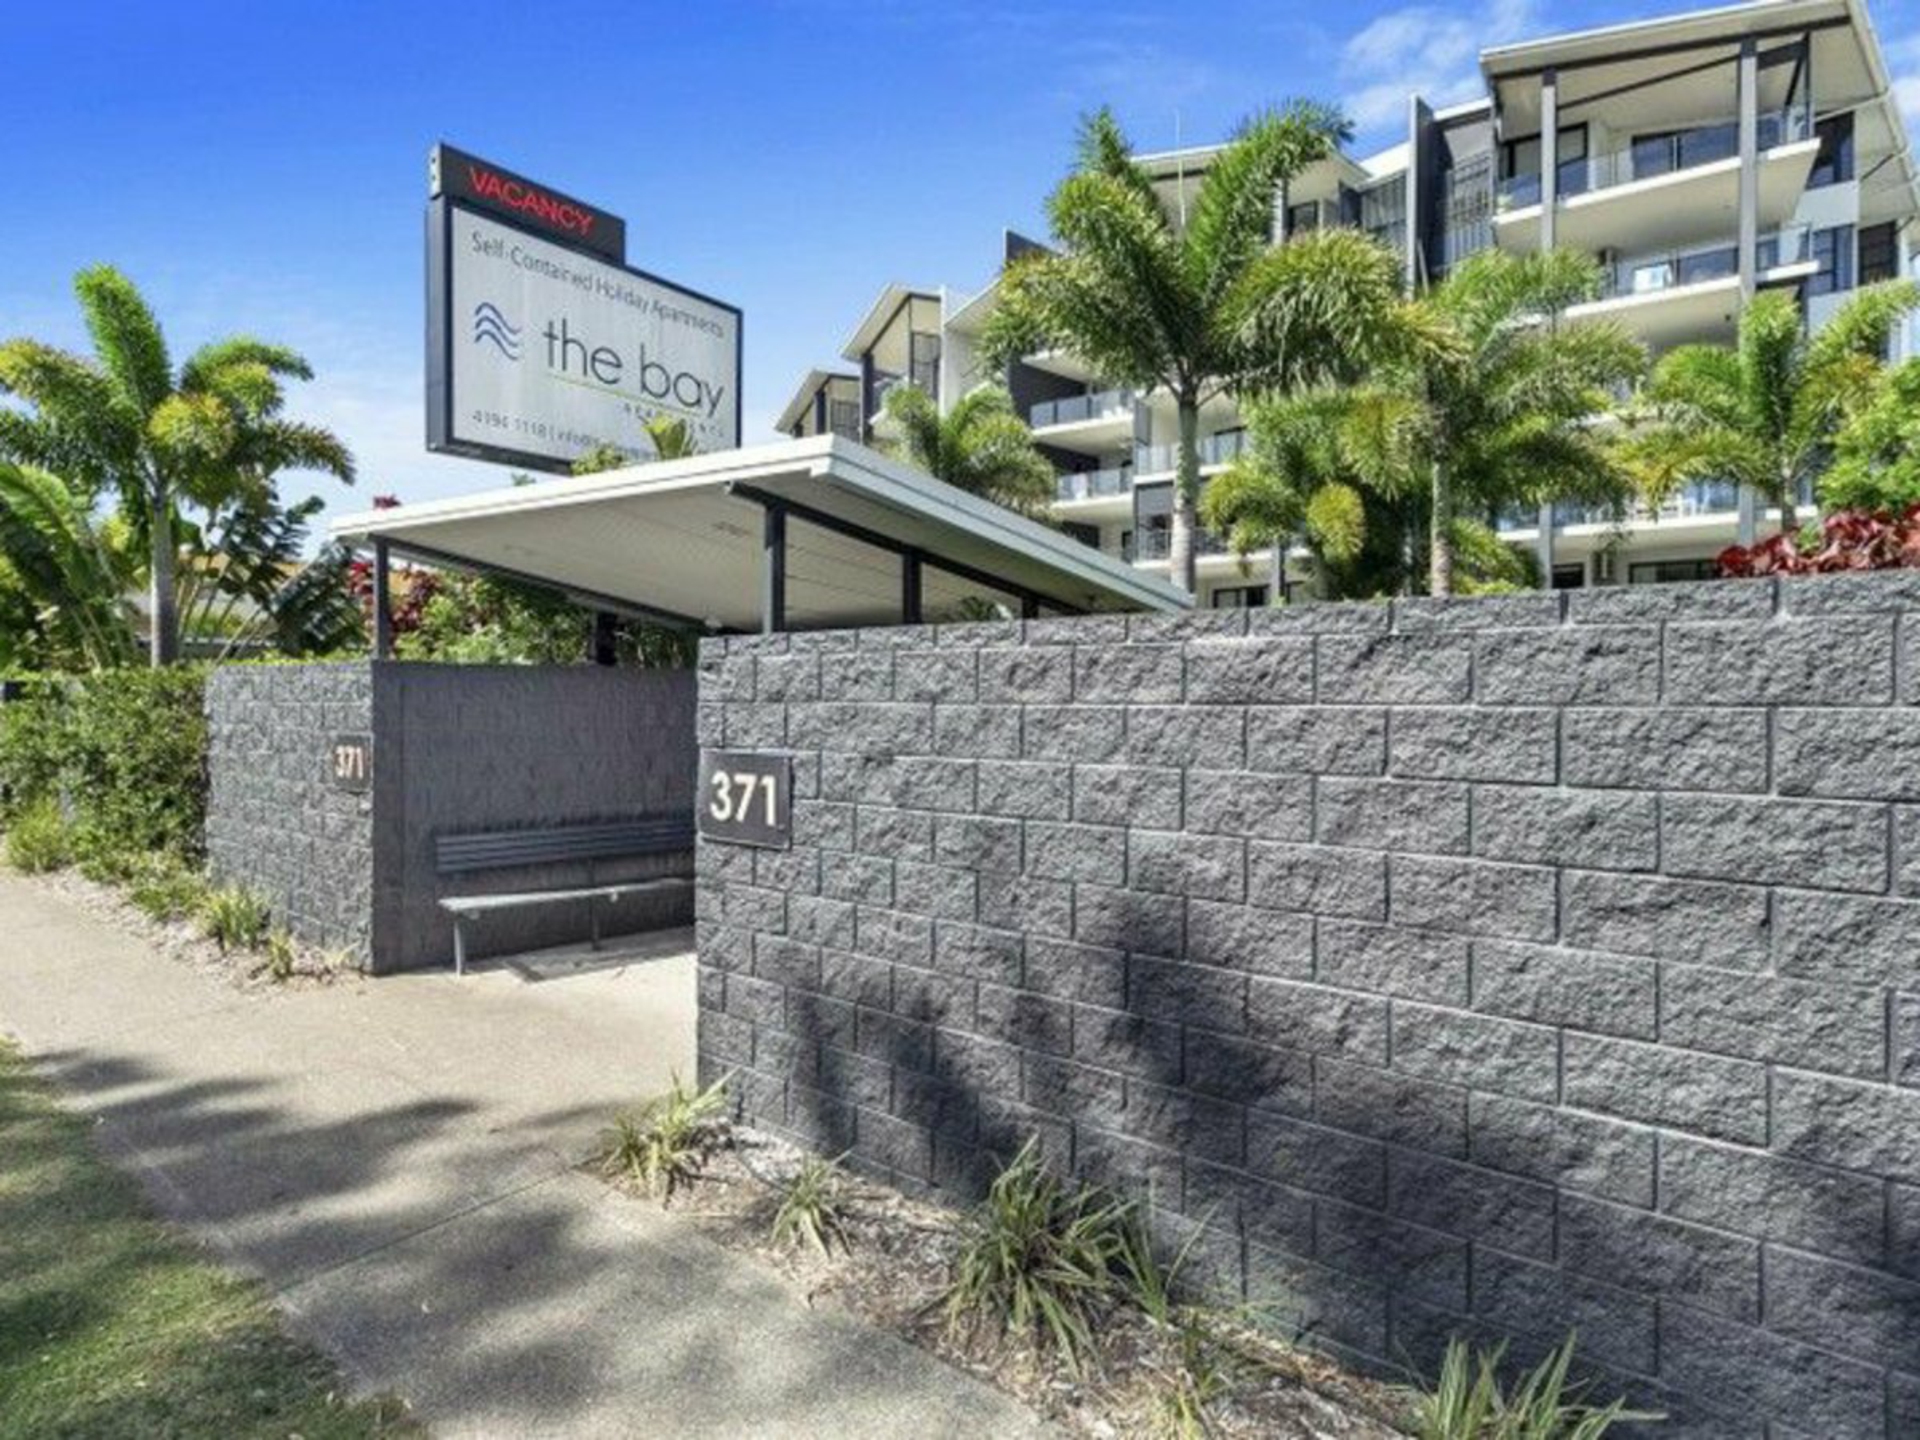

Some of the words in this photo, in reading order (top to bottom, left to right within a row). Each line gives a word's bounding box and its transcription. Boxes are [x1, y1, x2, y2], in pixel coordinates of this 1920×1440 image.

[469, 165, 593, 236] VACANCY
[595, 277, 648, 314] Holiday
[542, 317, 623, 385] the
[639, 342, 725, 419] bay
[334, 745, 364, 780] 371
[710, 770, 776, 827] 371
